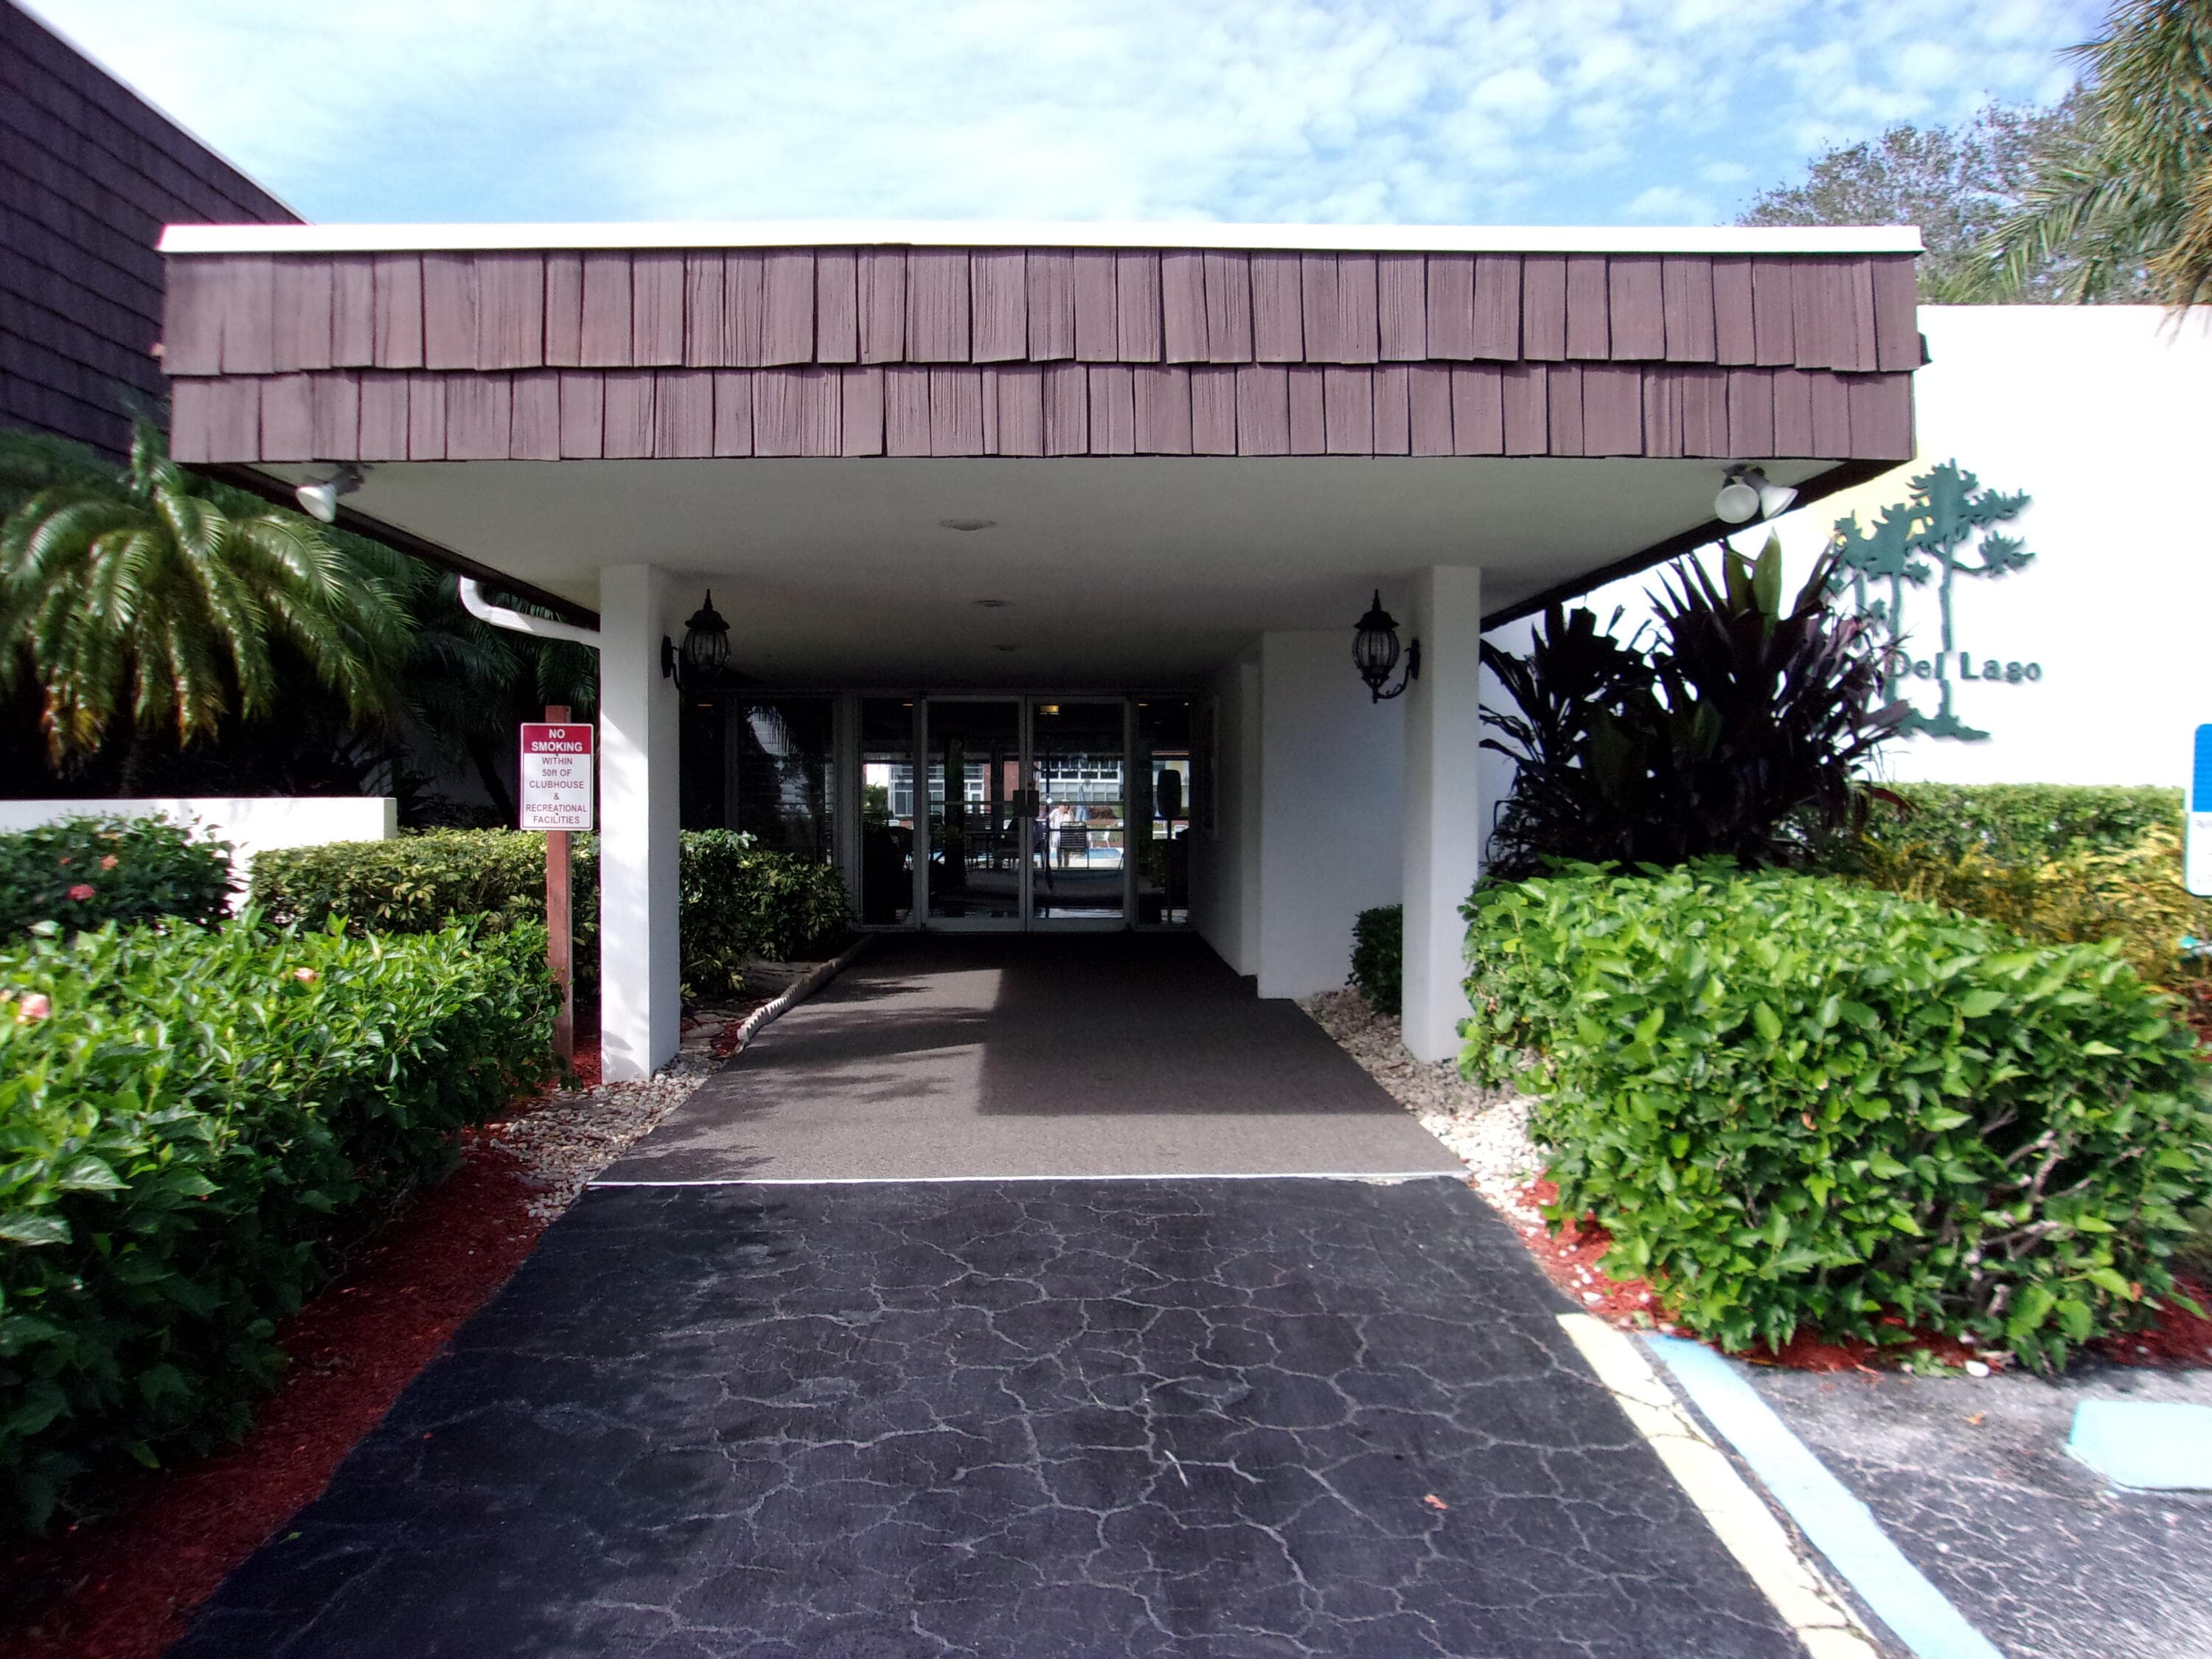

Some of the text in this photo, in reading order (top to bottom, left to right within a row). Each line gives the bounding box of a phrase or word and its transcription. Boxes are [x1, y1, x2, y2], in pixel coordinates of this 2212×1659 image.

[1961, 651, 2042, 684] Lago
[549, 728, 566, 739] NO
[531, 742, 582, 752] SMOKING
[542, 757, 573, 765] WITHIN
[542, 769, 572, 777] 50ft OF
[529, 781, 585, 789] CLUBHOUSE
[526, 804, 588, 813] RECREATIONAL
[533, 815, 580, 824] FACILITIES
